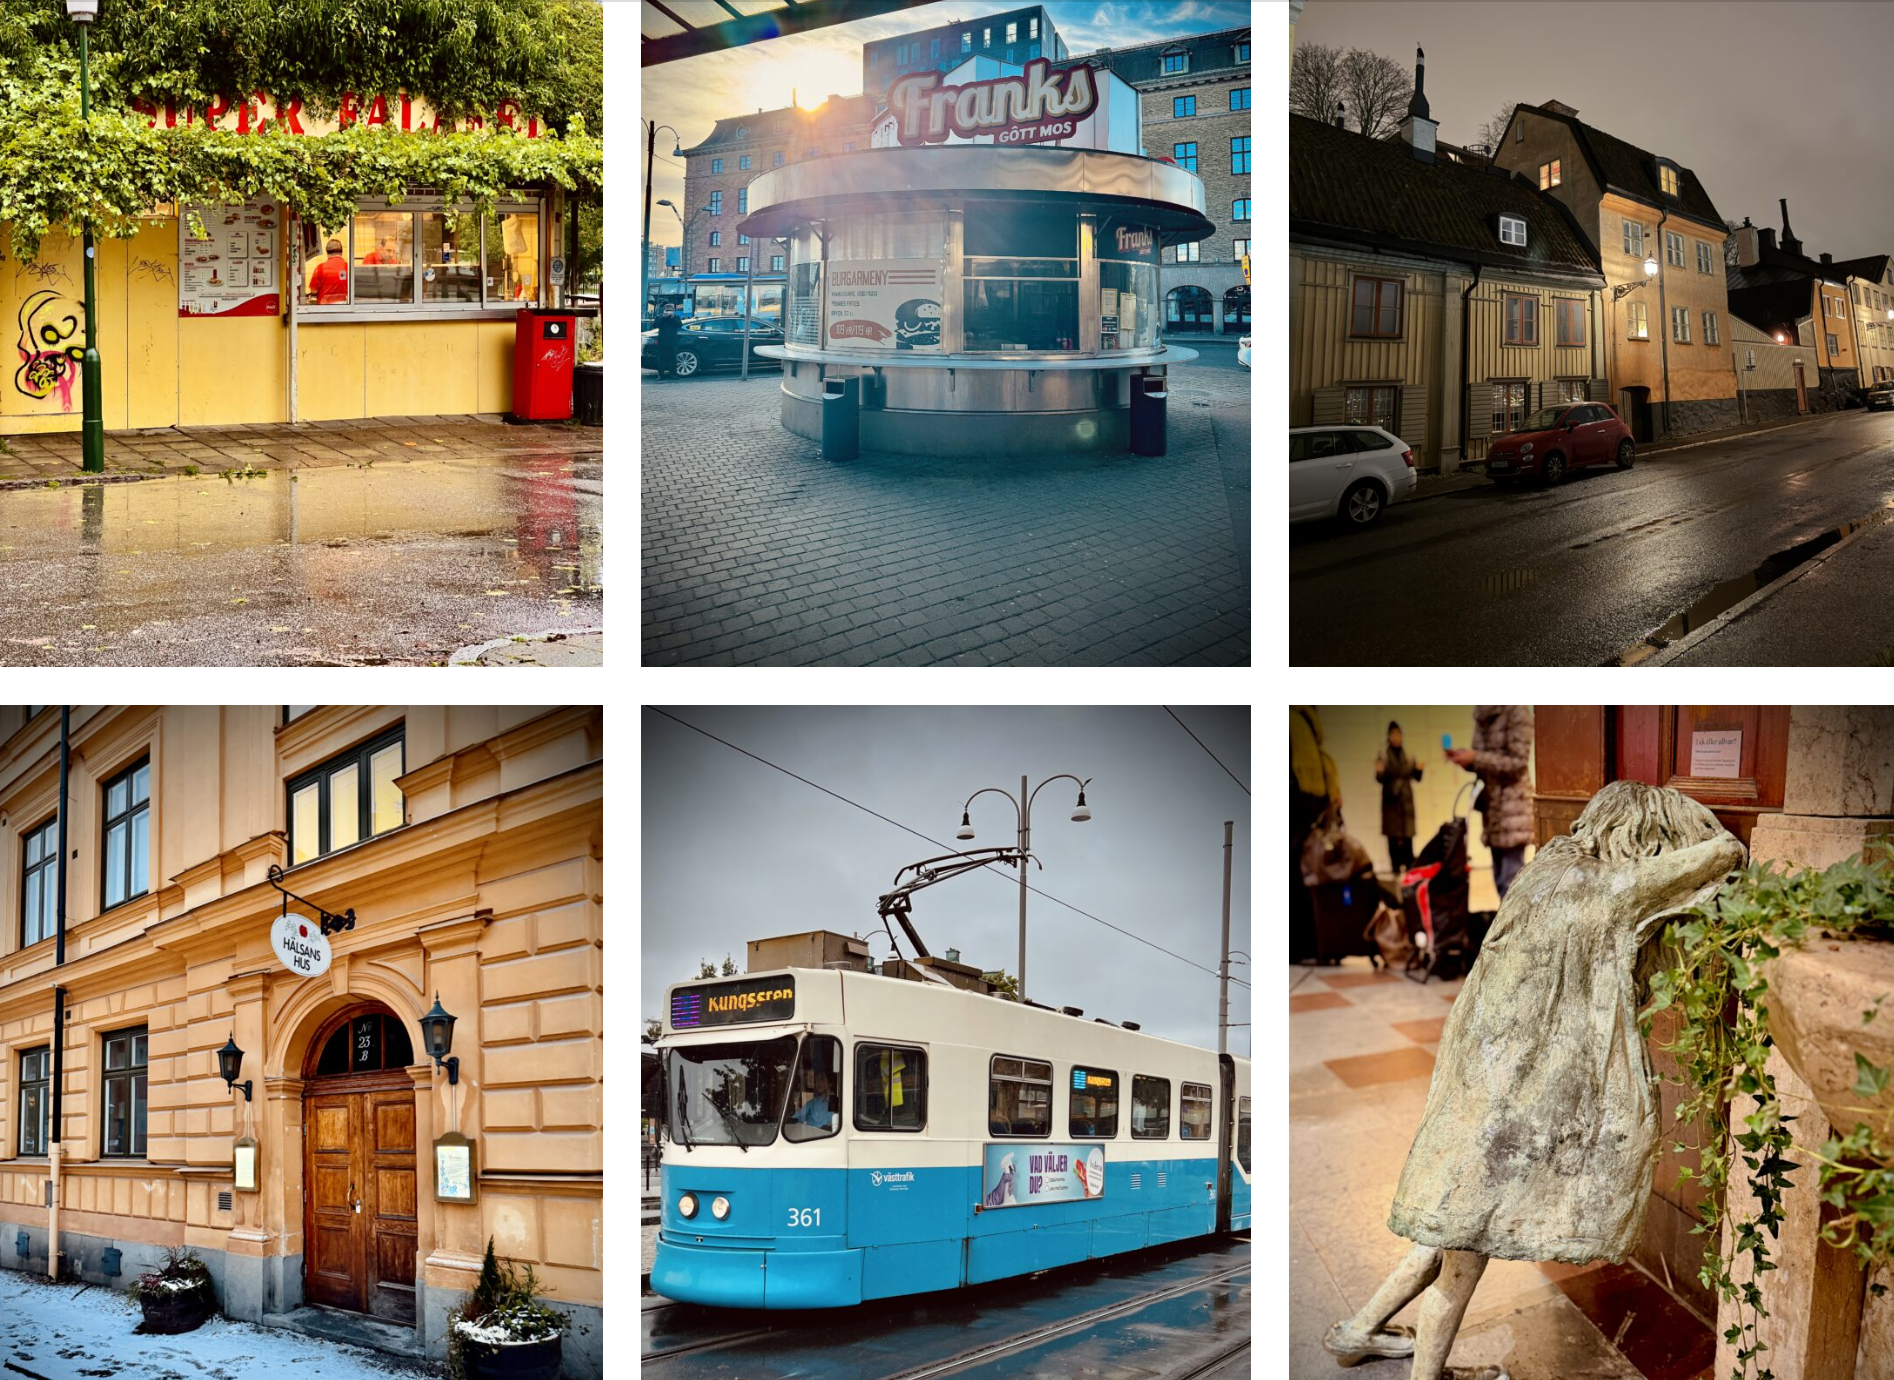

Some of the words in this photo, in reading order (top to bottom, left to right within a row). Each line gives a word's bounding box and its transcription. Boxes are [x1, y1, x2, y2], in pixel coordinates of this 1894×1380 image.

[893, 61, 1092, 139] Franks
[1039, 121, 1072, 137] MOS
[1116, 226, 1153, 251] Franks
[831, 270, 888, 287] BURGARMENY
[283, 936, 321, 961] HÄLSANS
[293, 955, 311, 971] HUS
[357, 1036, 371, 1049] 23
[358, 1050, 369, 1062] B
[1030, 1155, 1042, 1173] VAD
[1044, 1151, 1067, 1172] VÄLJER
[883, 1171, 915, 1182] västtrafik
[1030, 1176, 1042, 1194] DU?
[786, 1207, 821, 1227] 361
